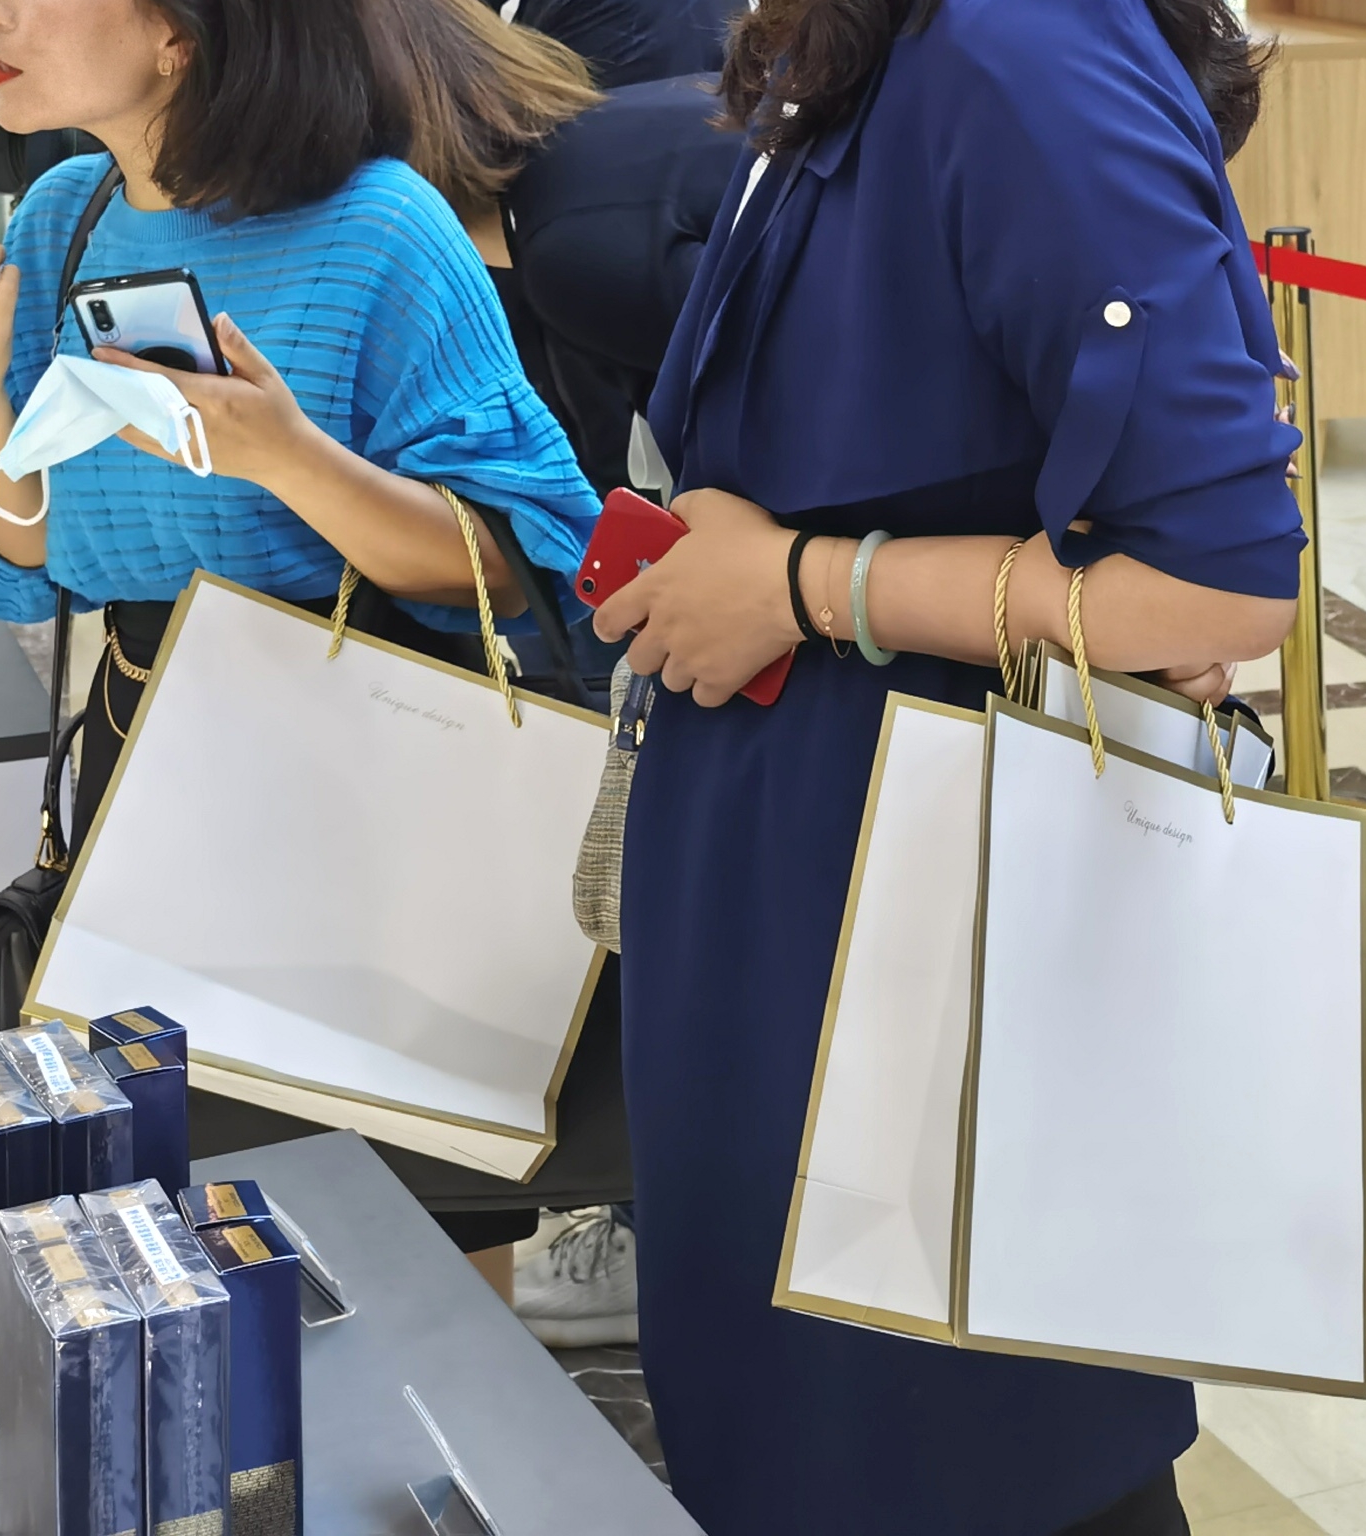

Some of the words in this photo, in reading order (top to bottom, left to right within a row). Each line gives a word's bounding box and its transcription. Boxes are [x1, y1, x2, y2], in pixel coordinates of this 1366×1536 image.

[368, 681, 420, 714] Unique
[422, 708, 466, 731] design
[1123, 800, 1162, 836] Unique
[1162, 821, 1194, 848] design
